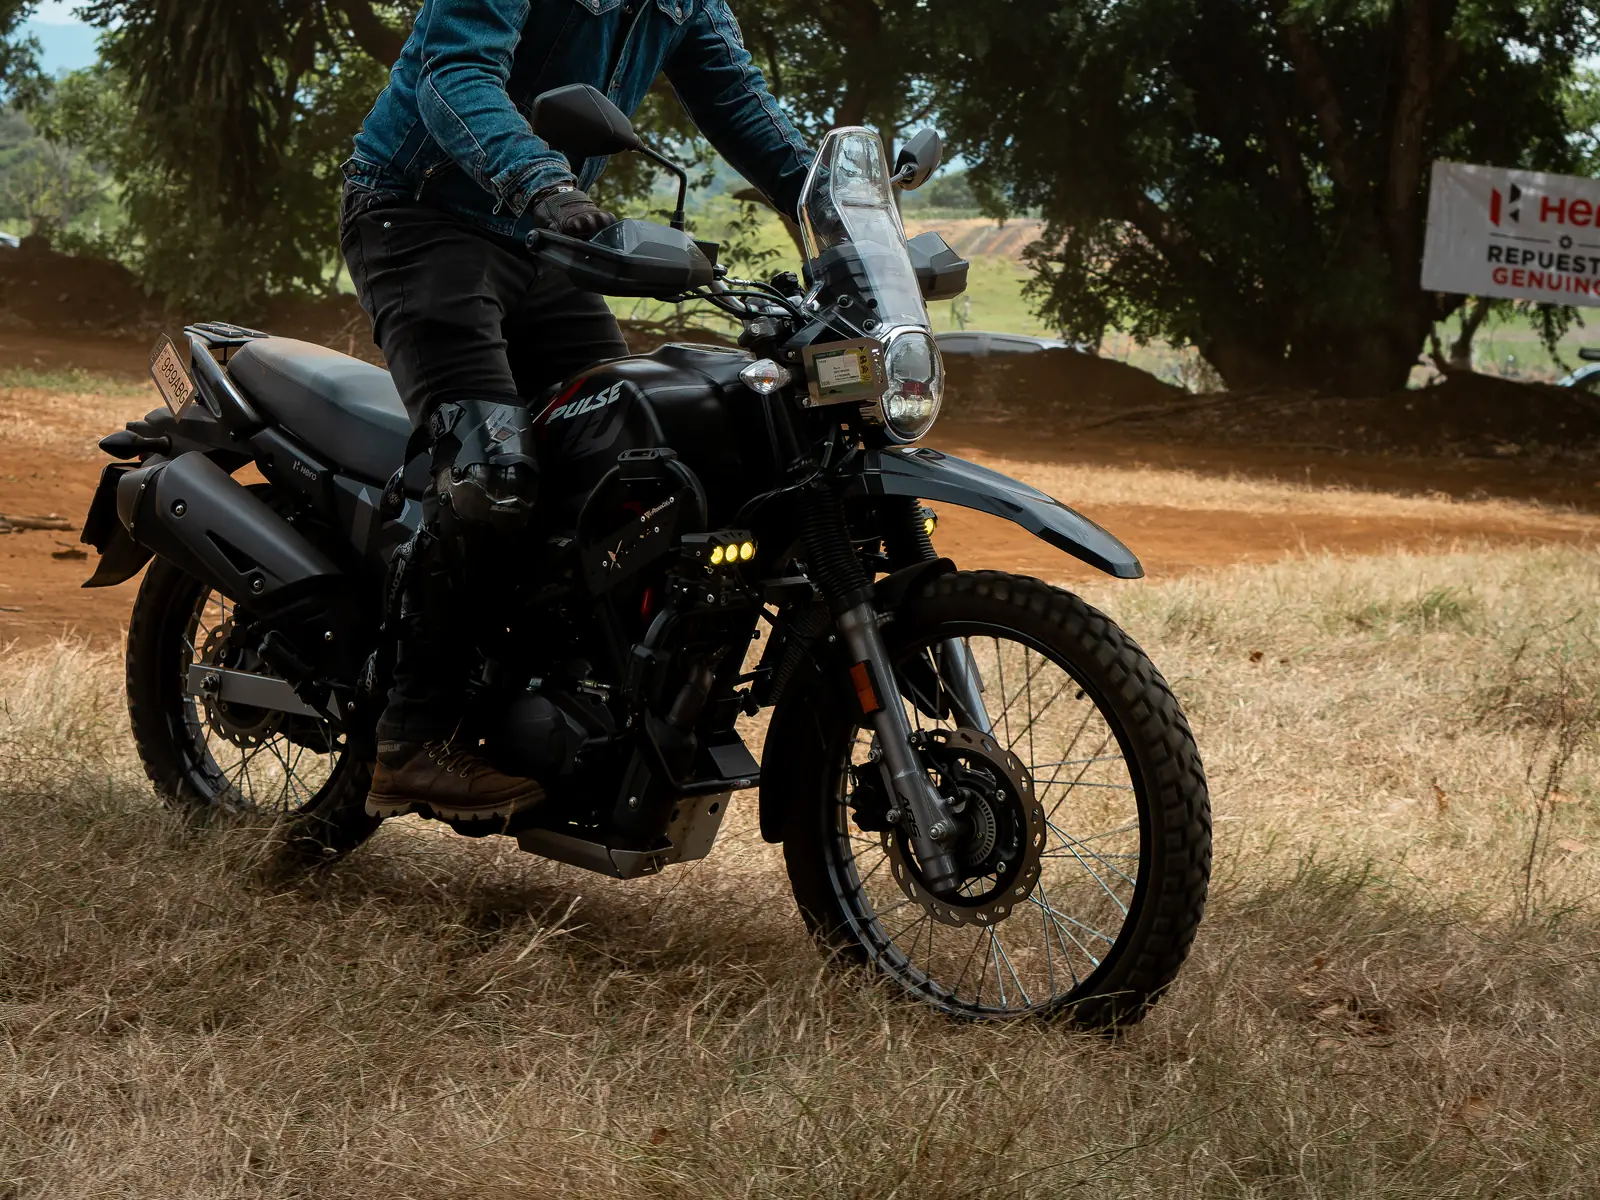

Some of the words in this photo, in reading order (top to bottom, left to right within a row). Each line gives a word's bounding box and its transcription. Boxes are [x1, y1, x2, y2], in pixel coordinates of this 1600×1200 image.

[1487, 245, 1600, 274] REPUEST
[161, 357, 189, 404] 989ABG
[545, 380, 626, 426] PULSE
[300, 465, 317, 481] Hero
[898, 791, 922, 839] ABS
